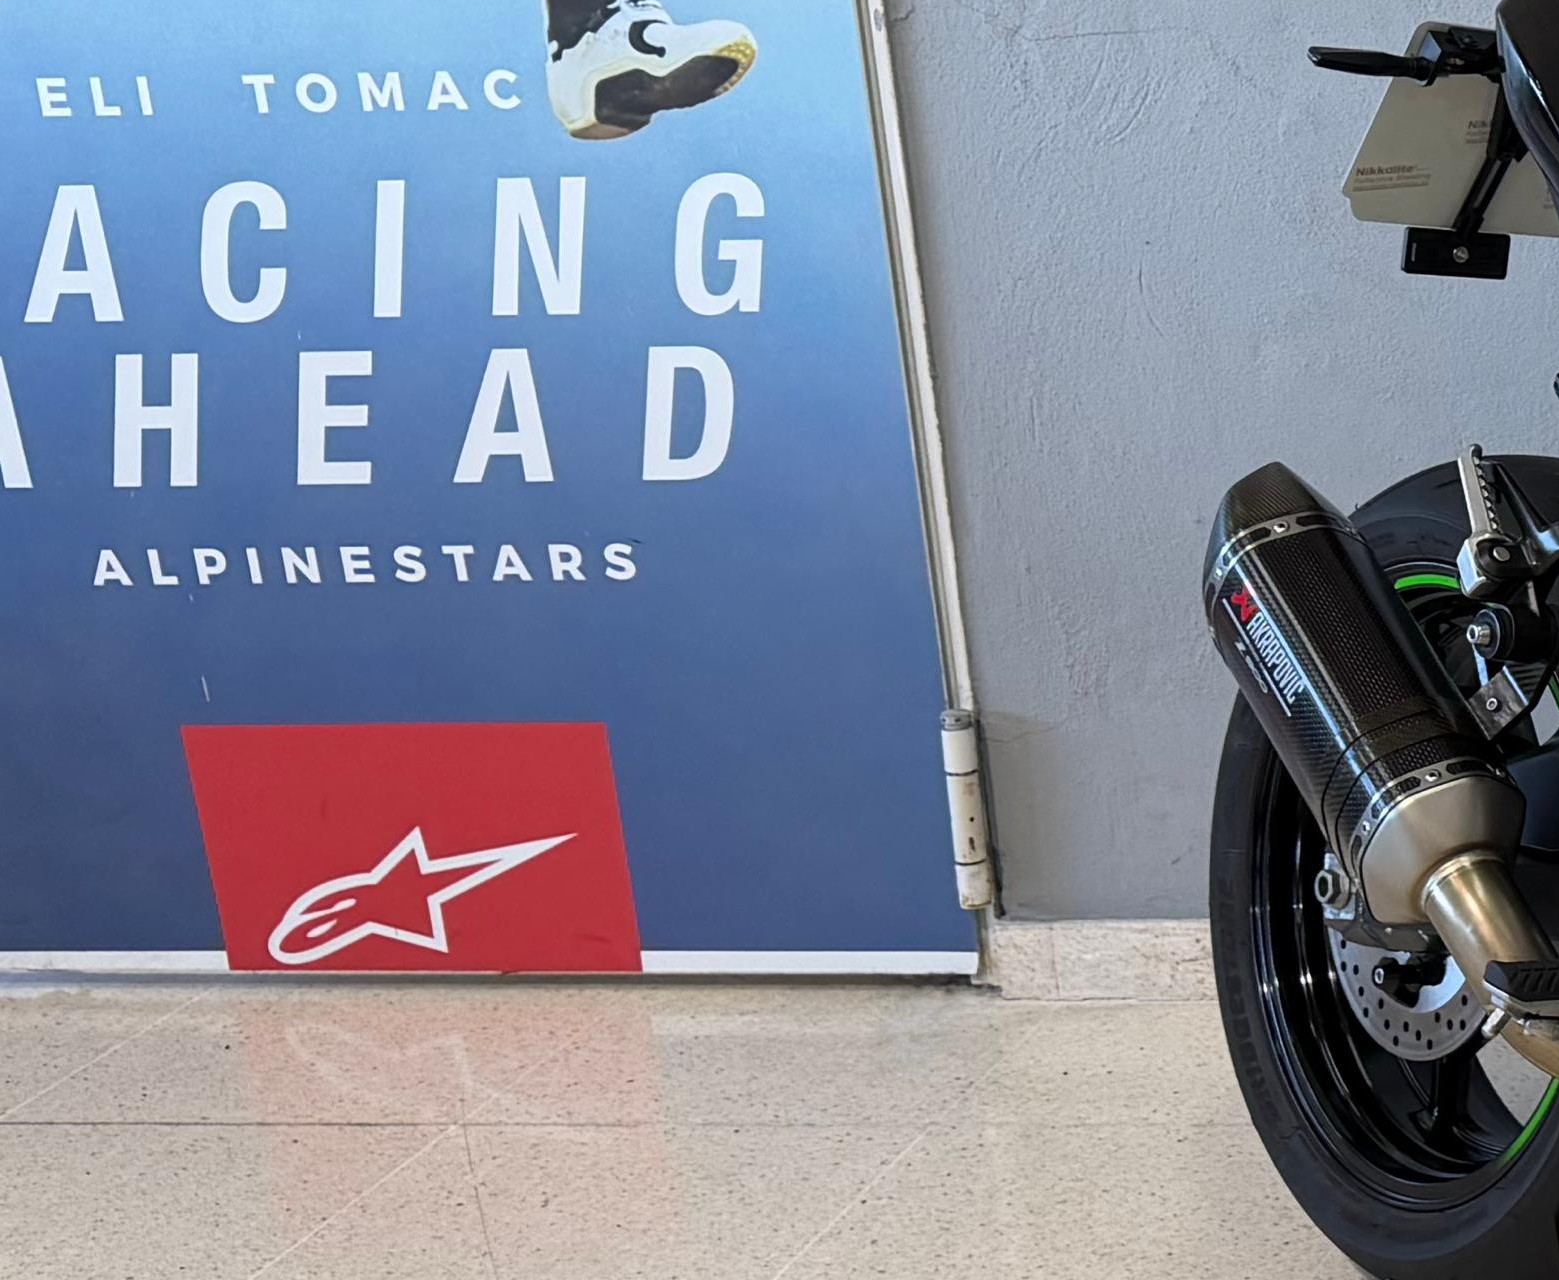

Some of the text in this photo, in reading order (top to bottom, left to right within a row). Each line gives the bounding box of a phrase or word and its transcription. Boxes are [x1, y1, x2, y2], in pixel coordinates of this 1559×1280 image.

[37, 69, 523, 117] ELI TOMAC
[24, 172, 766, 323] ACING
[93, 543, 639, 587] ALPINESTARS
